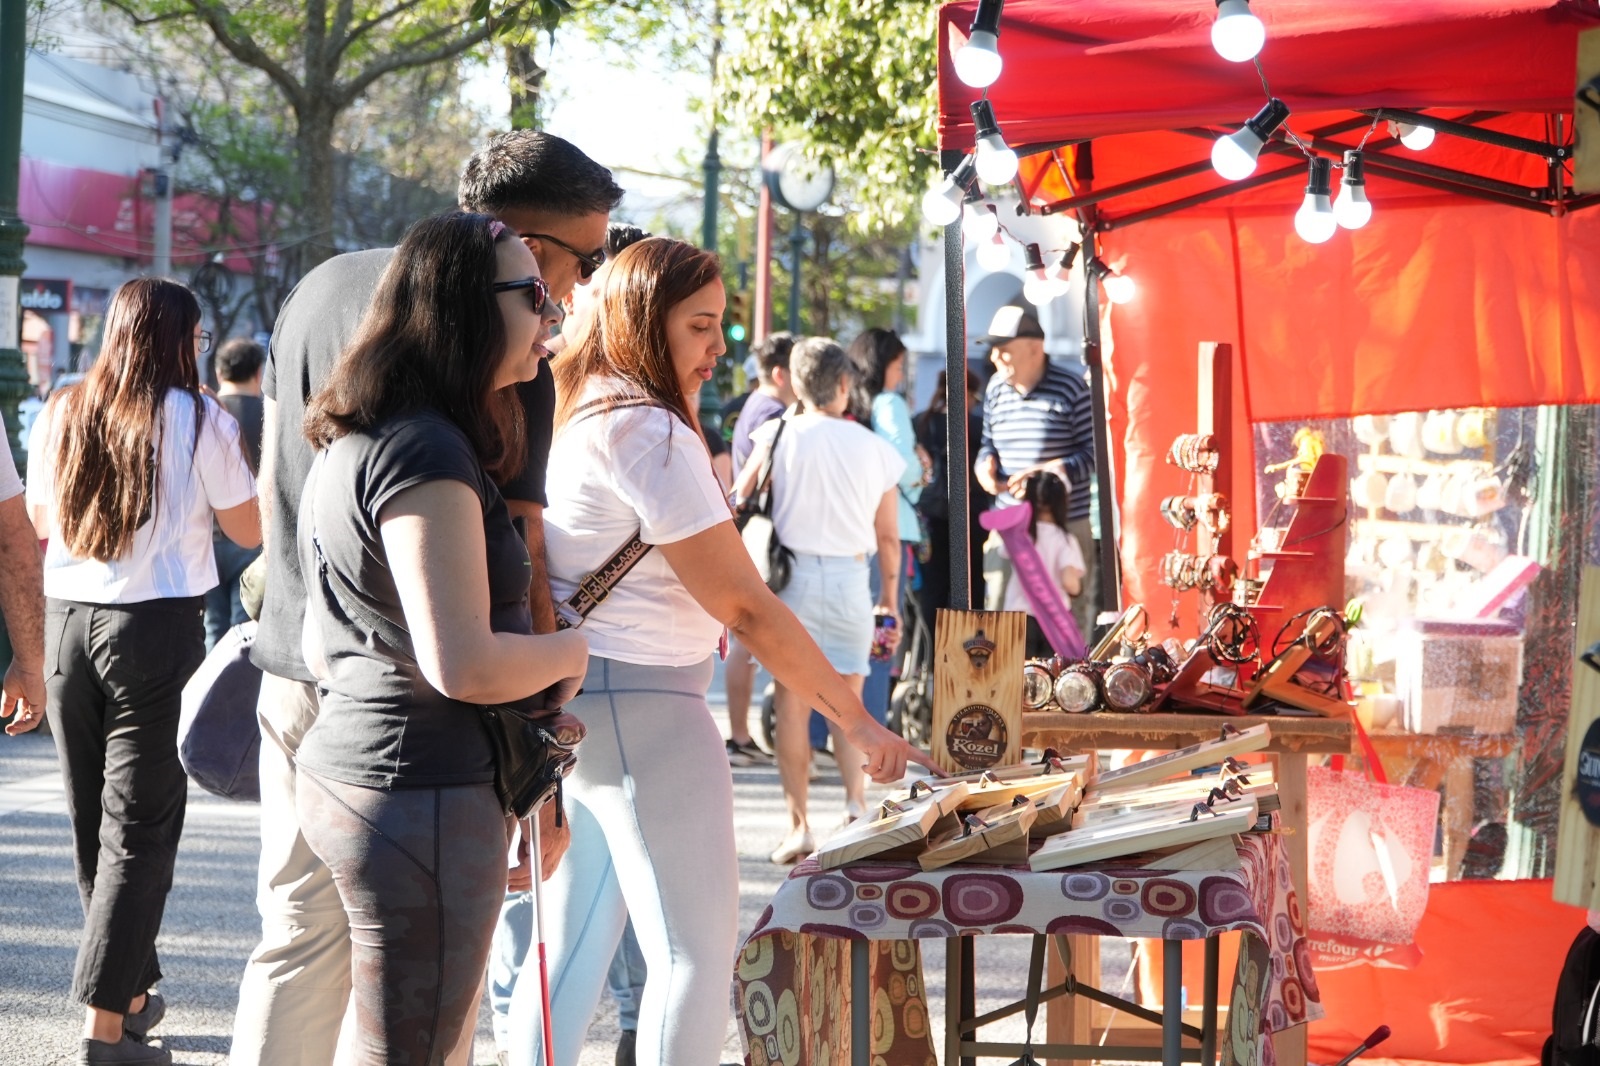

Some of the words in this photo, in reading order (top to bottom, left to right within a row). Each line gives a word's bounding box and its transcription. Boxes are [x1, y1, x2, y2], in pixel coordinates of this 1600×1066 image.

[613, 537, 646, 572] LARG
[952, 738, 999, 755] Kozel
[1307, 939, 1359, 956] rrefour
